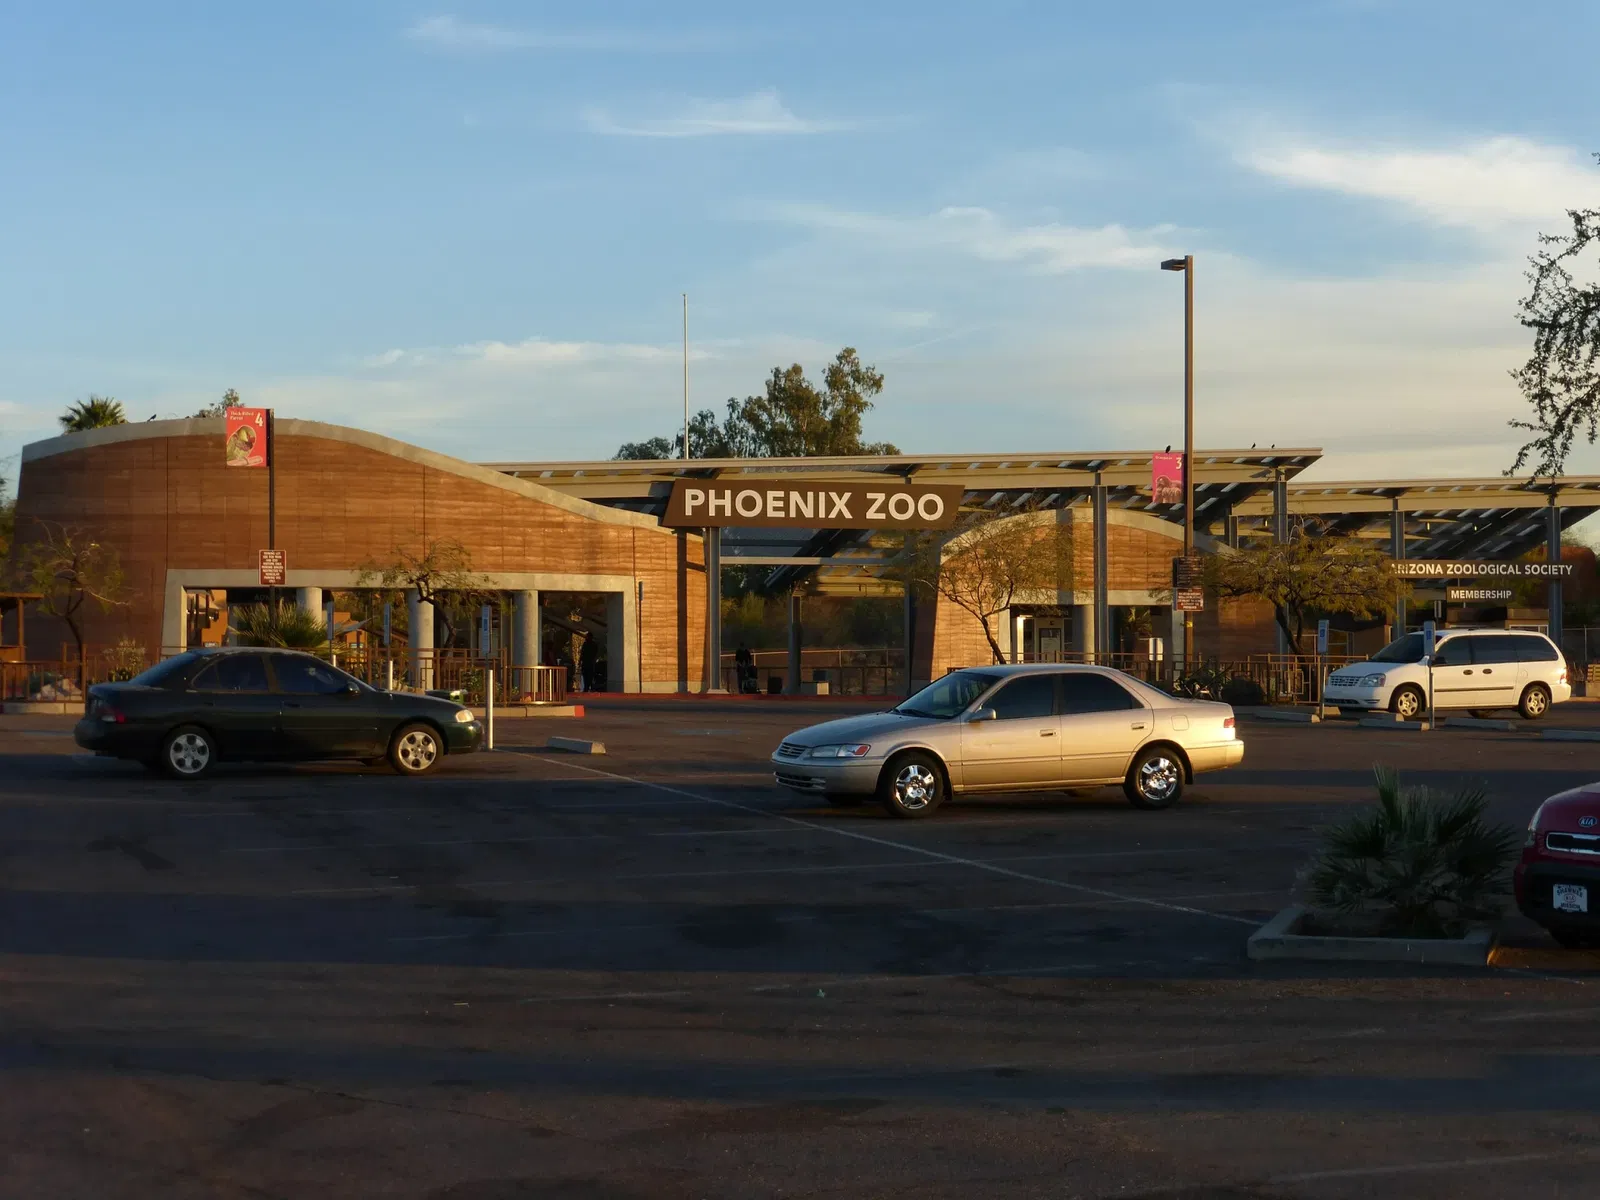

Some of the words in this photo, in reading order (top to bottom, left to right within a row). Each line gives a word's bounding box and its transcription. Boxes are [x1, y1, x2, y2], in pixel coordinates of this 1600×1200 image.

[255, 412, 264, 427] 4
[1175, 457, 1182, 470] 3
[684, 488, 854, 519] PHOENIX
[865, 493, 945, 521] ZOO
[1446, 563, 1521, 576] ZOOLOGICAL
[1524, 564, 1573, 576] SOCIETY
[1450, 590, 1512, 599] MEMBERSHIP
